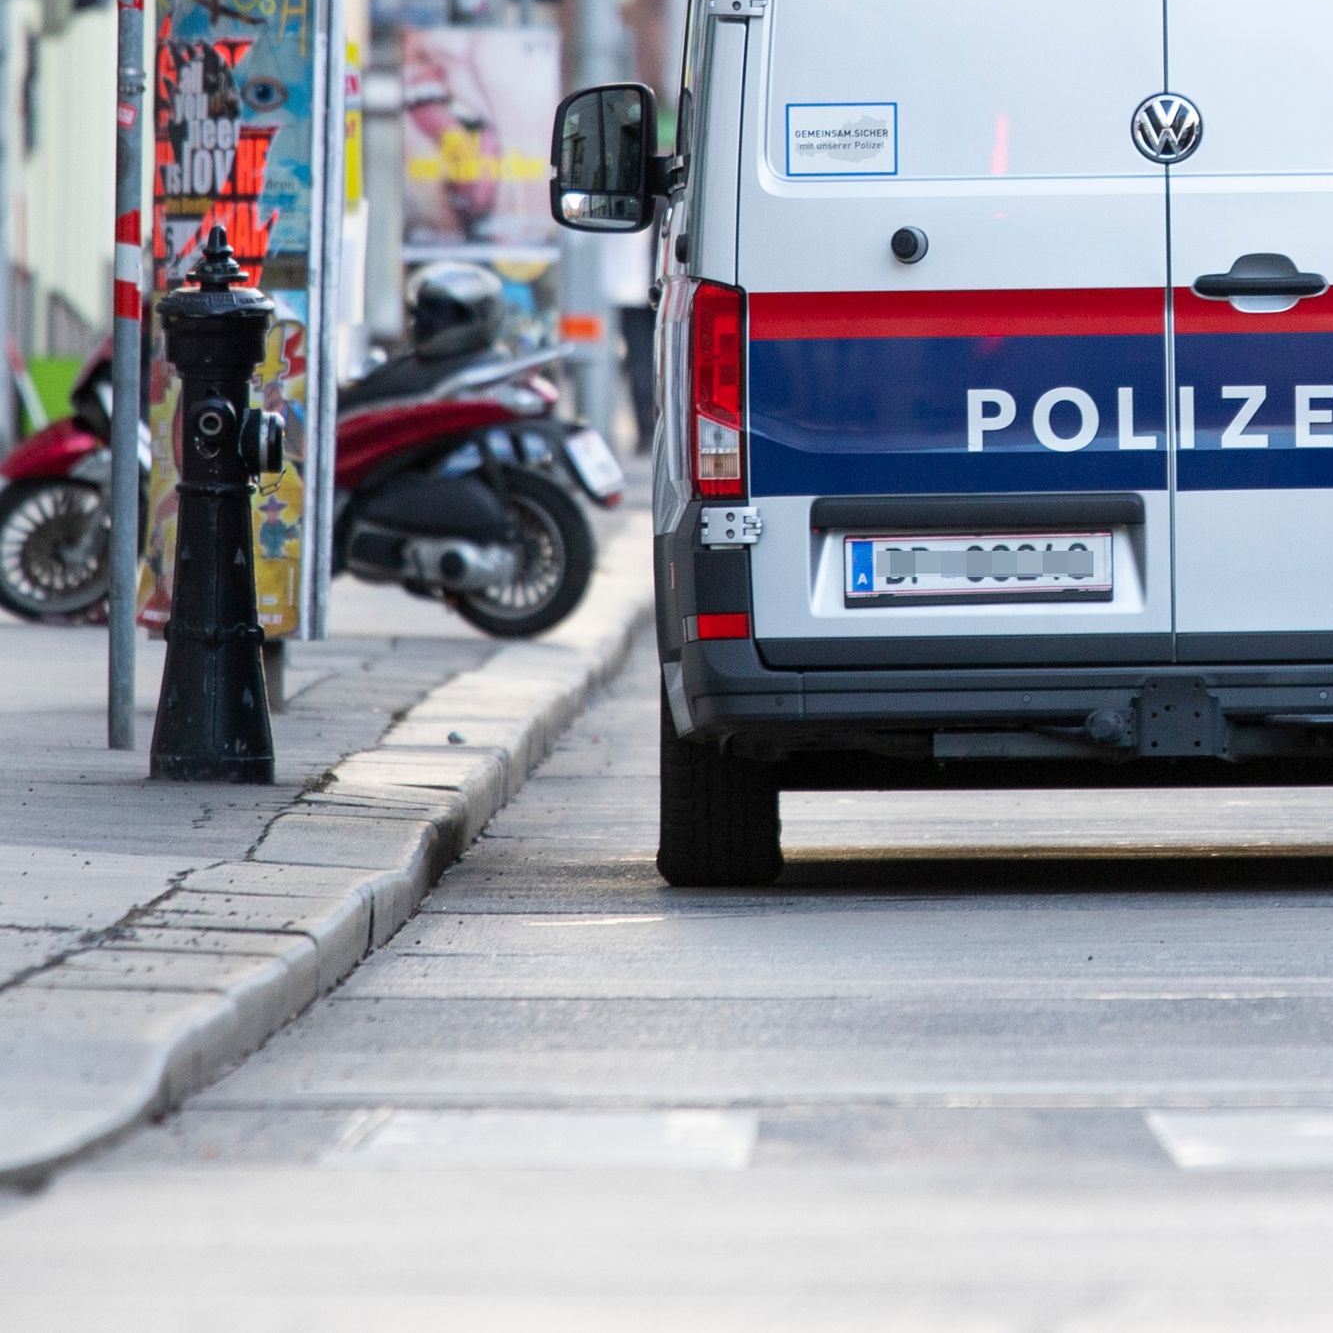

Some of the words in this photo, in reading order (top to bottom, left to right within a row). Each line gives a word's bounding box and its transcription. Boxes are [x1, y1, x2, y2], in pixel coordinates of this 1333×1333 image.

[795, 128, 889, 139] GEMEINSAM.SICHER
[799, 142, 814, 151] mit
[816, 141, 852, 151] unserer
[854, 140, 885, 150] Polizei
[857, 573, 868, 585] A
